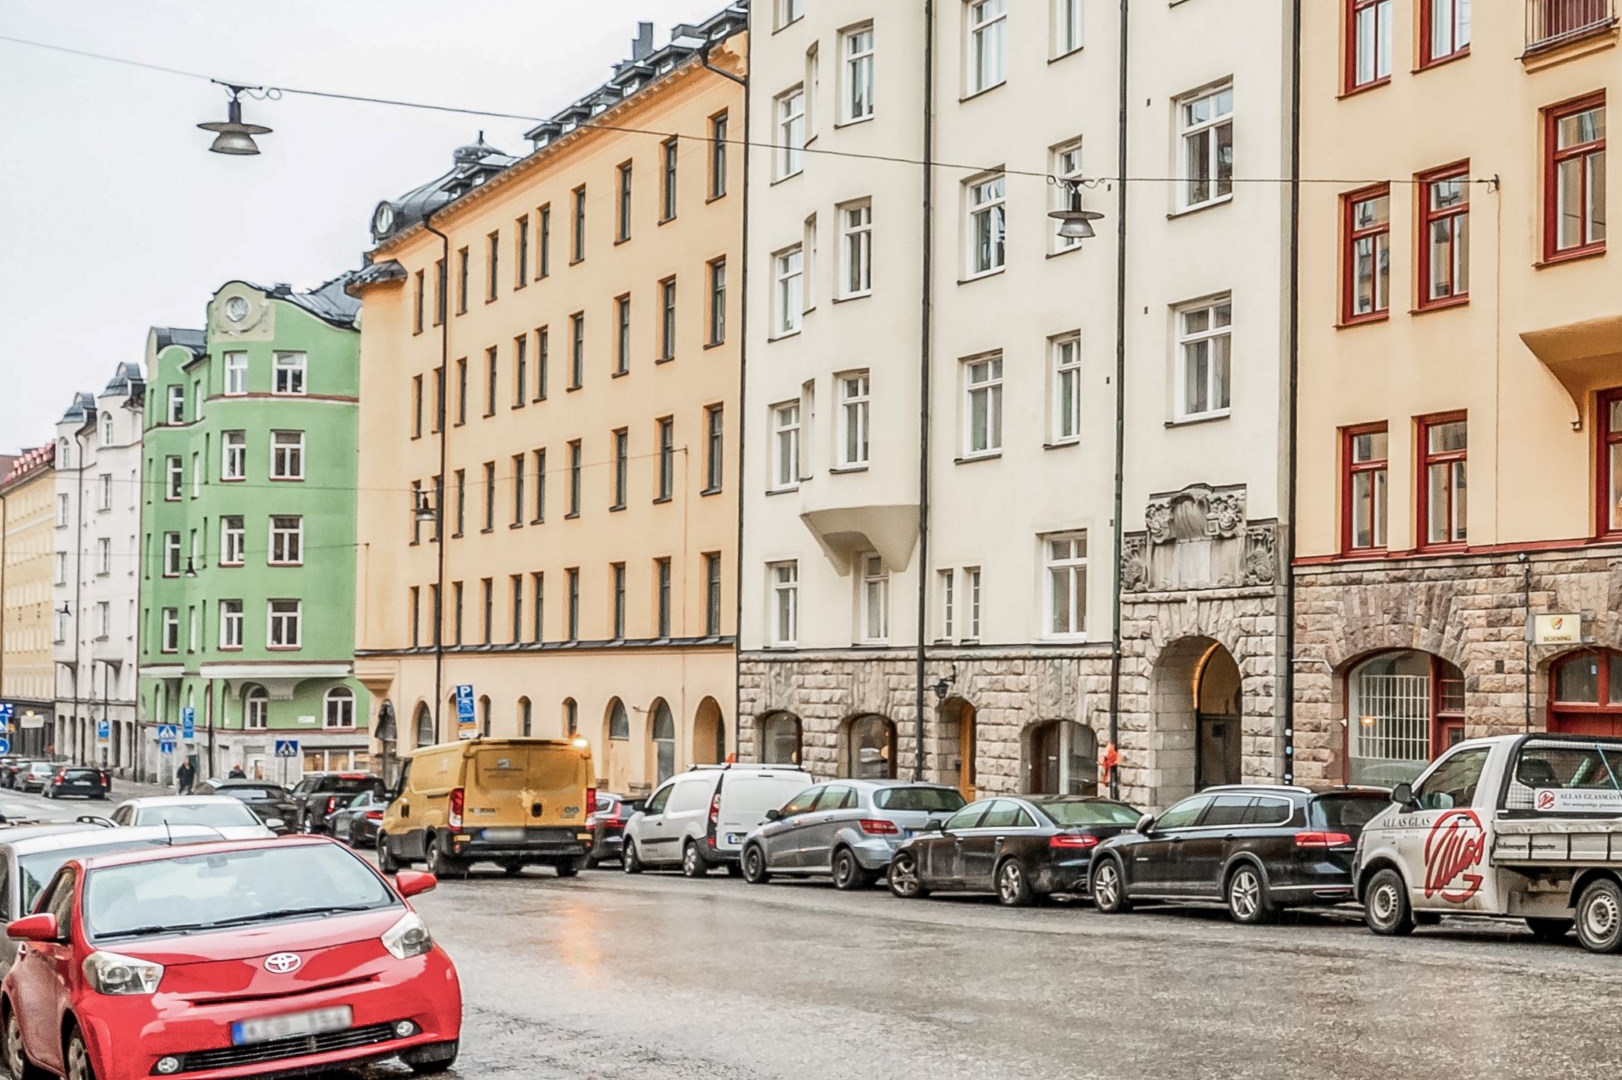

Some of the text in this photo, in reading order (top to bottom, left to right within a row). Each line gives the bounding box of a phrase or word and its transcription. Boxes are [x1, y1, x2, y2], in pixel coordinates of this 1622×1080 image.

[1560, 793, 1582, 801] ALLAS
[1383, 816, 1430, 827] ALLAS GLAS
